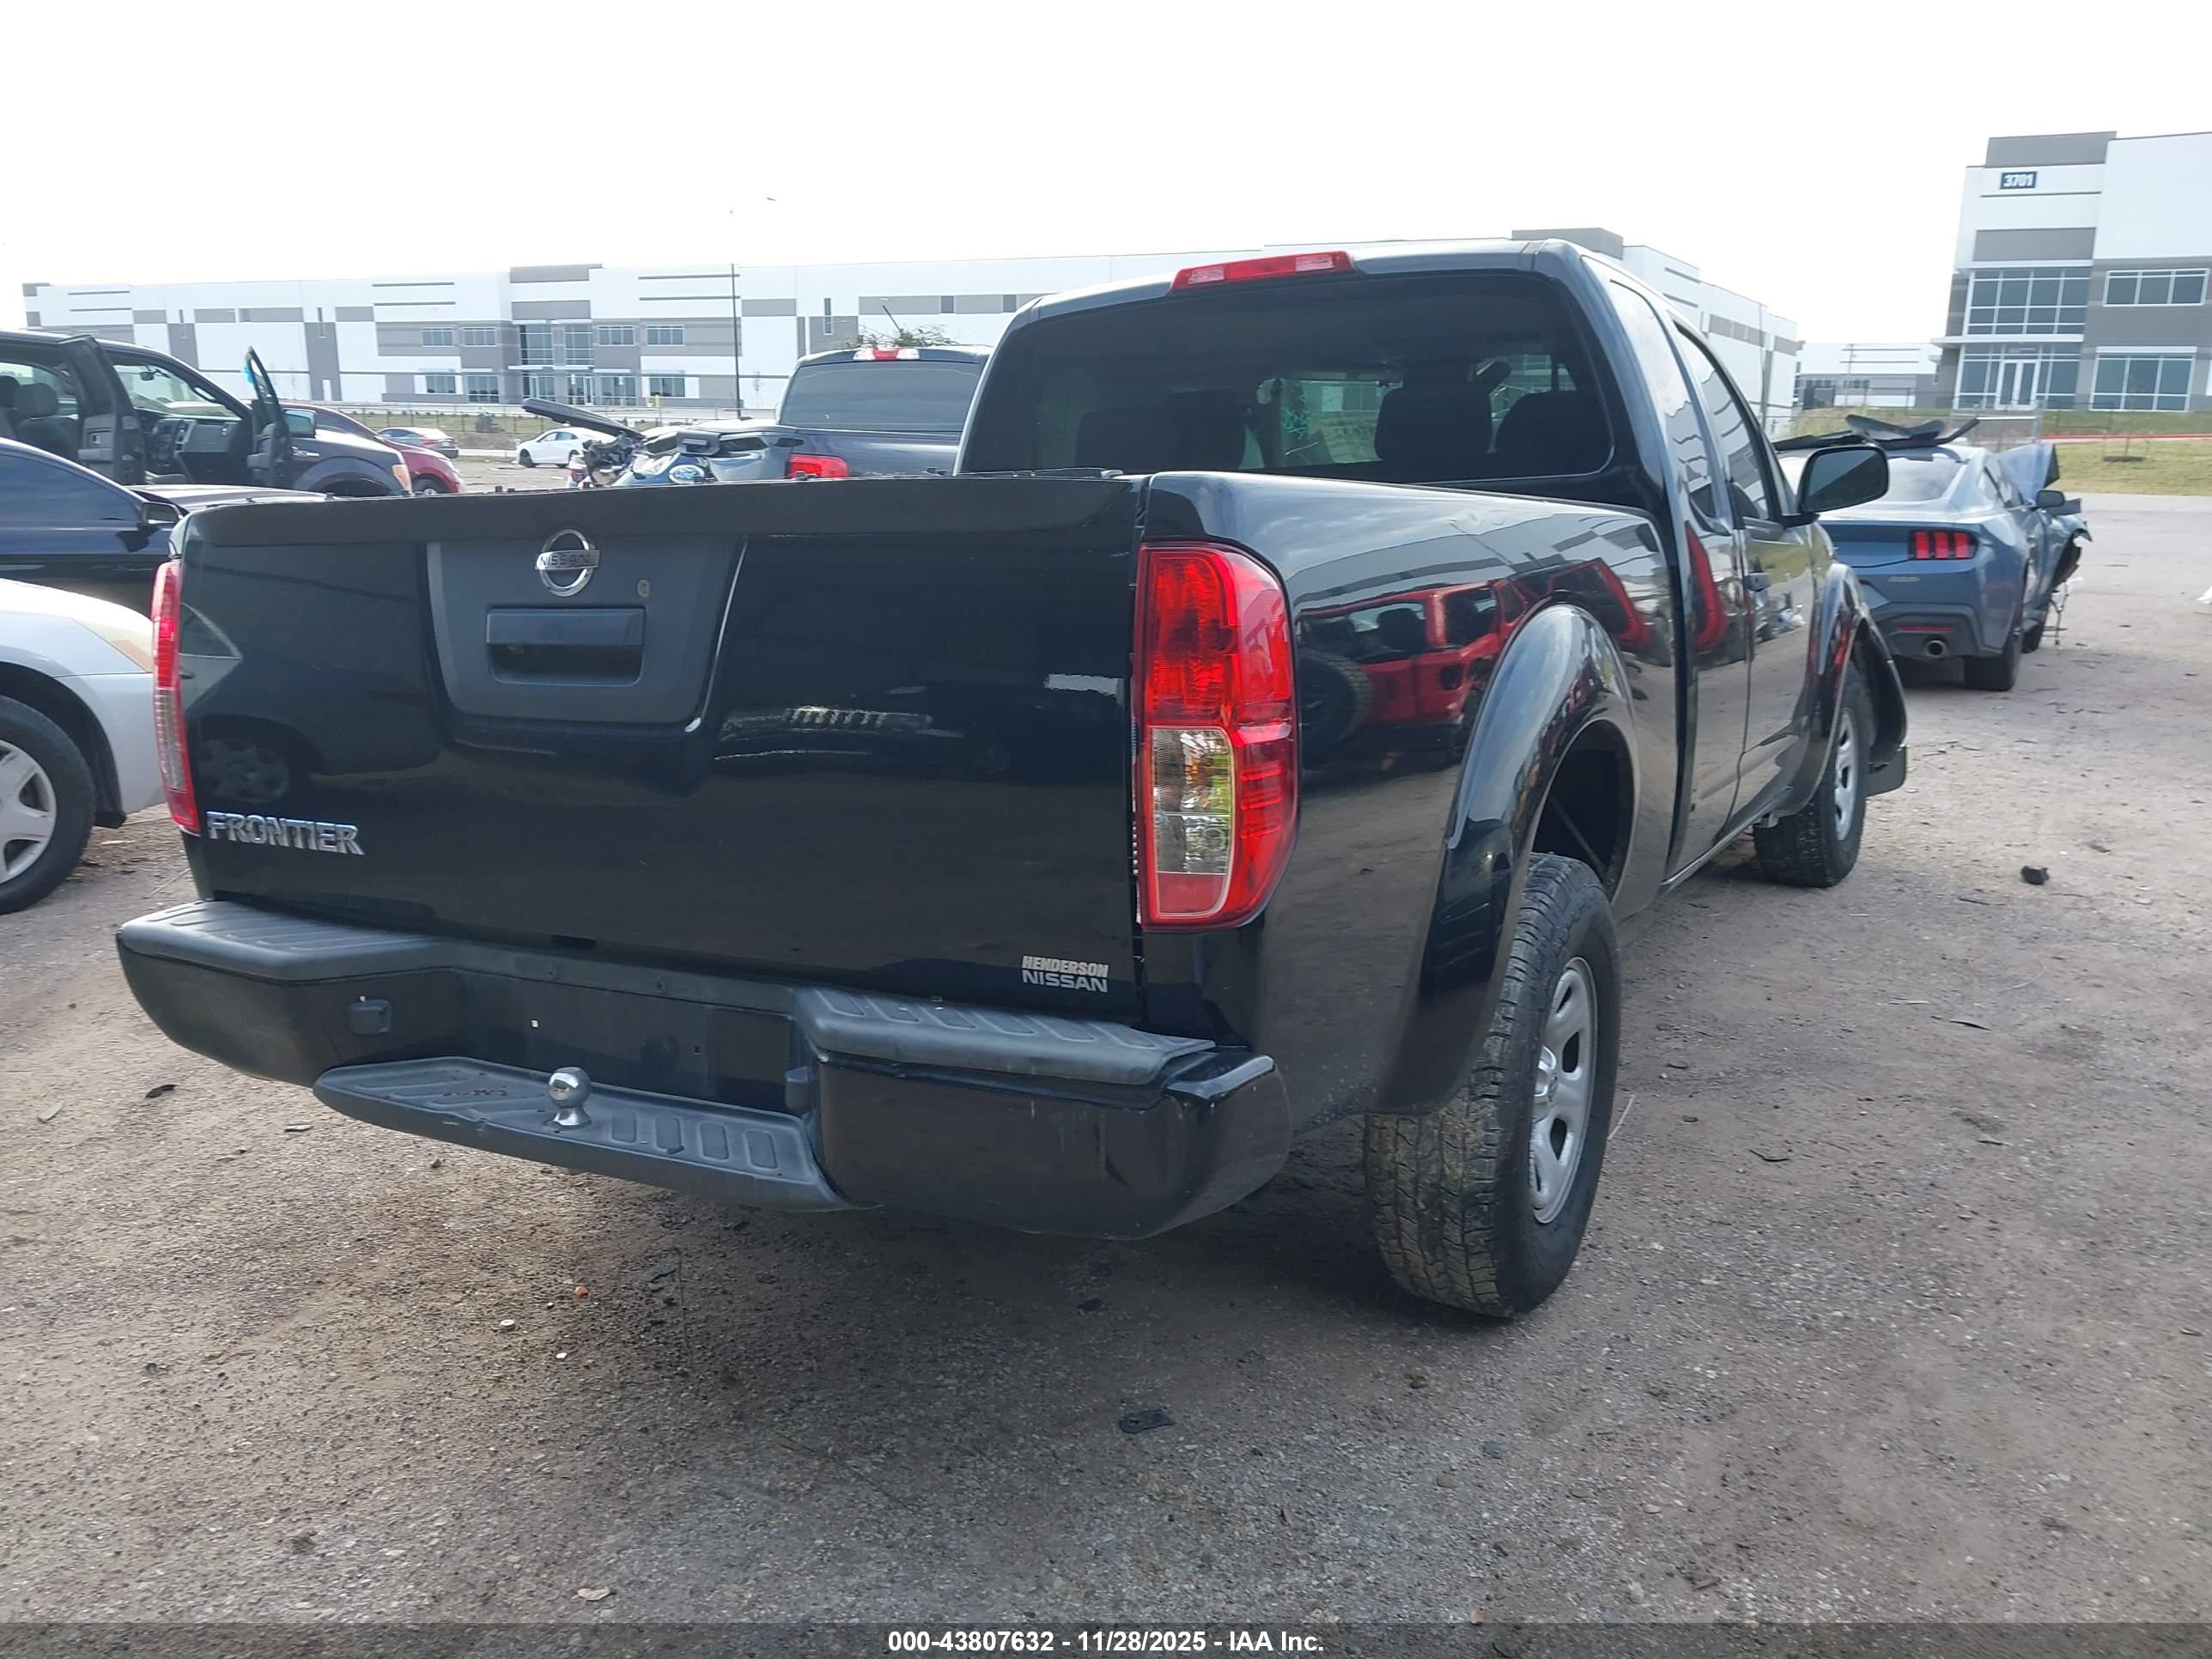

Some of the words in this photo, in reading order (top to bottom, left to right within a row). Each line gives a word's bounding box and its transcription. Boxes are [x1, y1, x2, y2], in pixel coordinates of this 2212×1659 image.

[538, 554, 591, 566] NISSAN
[206, 811, 365, 855] FRONTIER
[1022, 955, 1109, 978] HENDERSON
[1022, 969, 1109, 993] NISSAN
